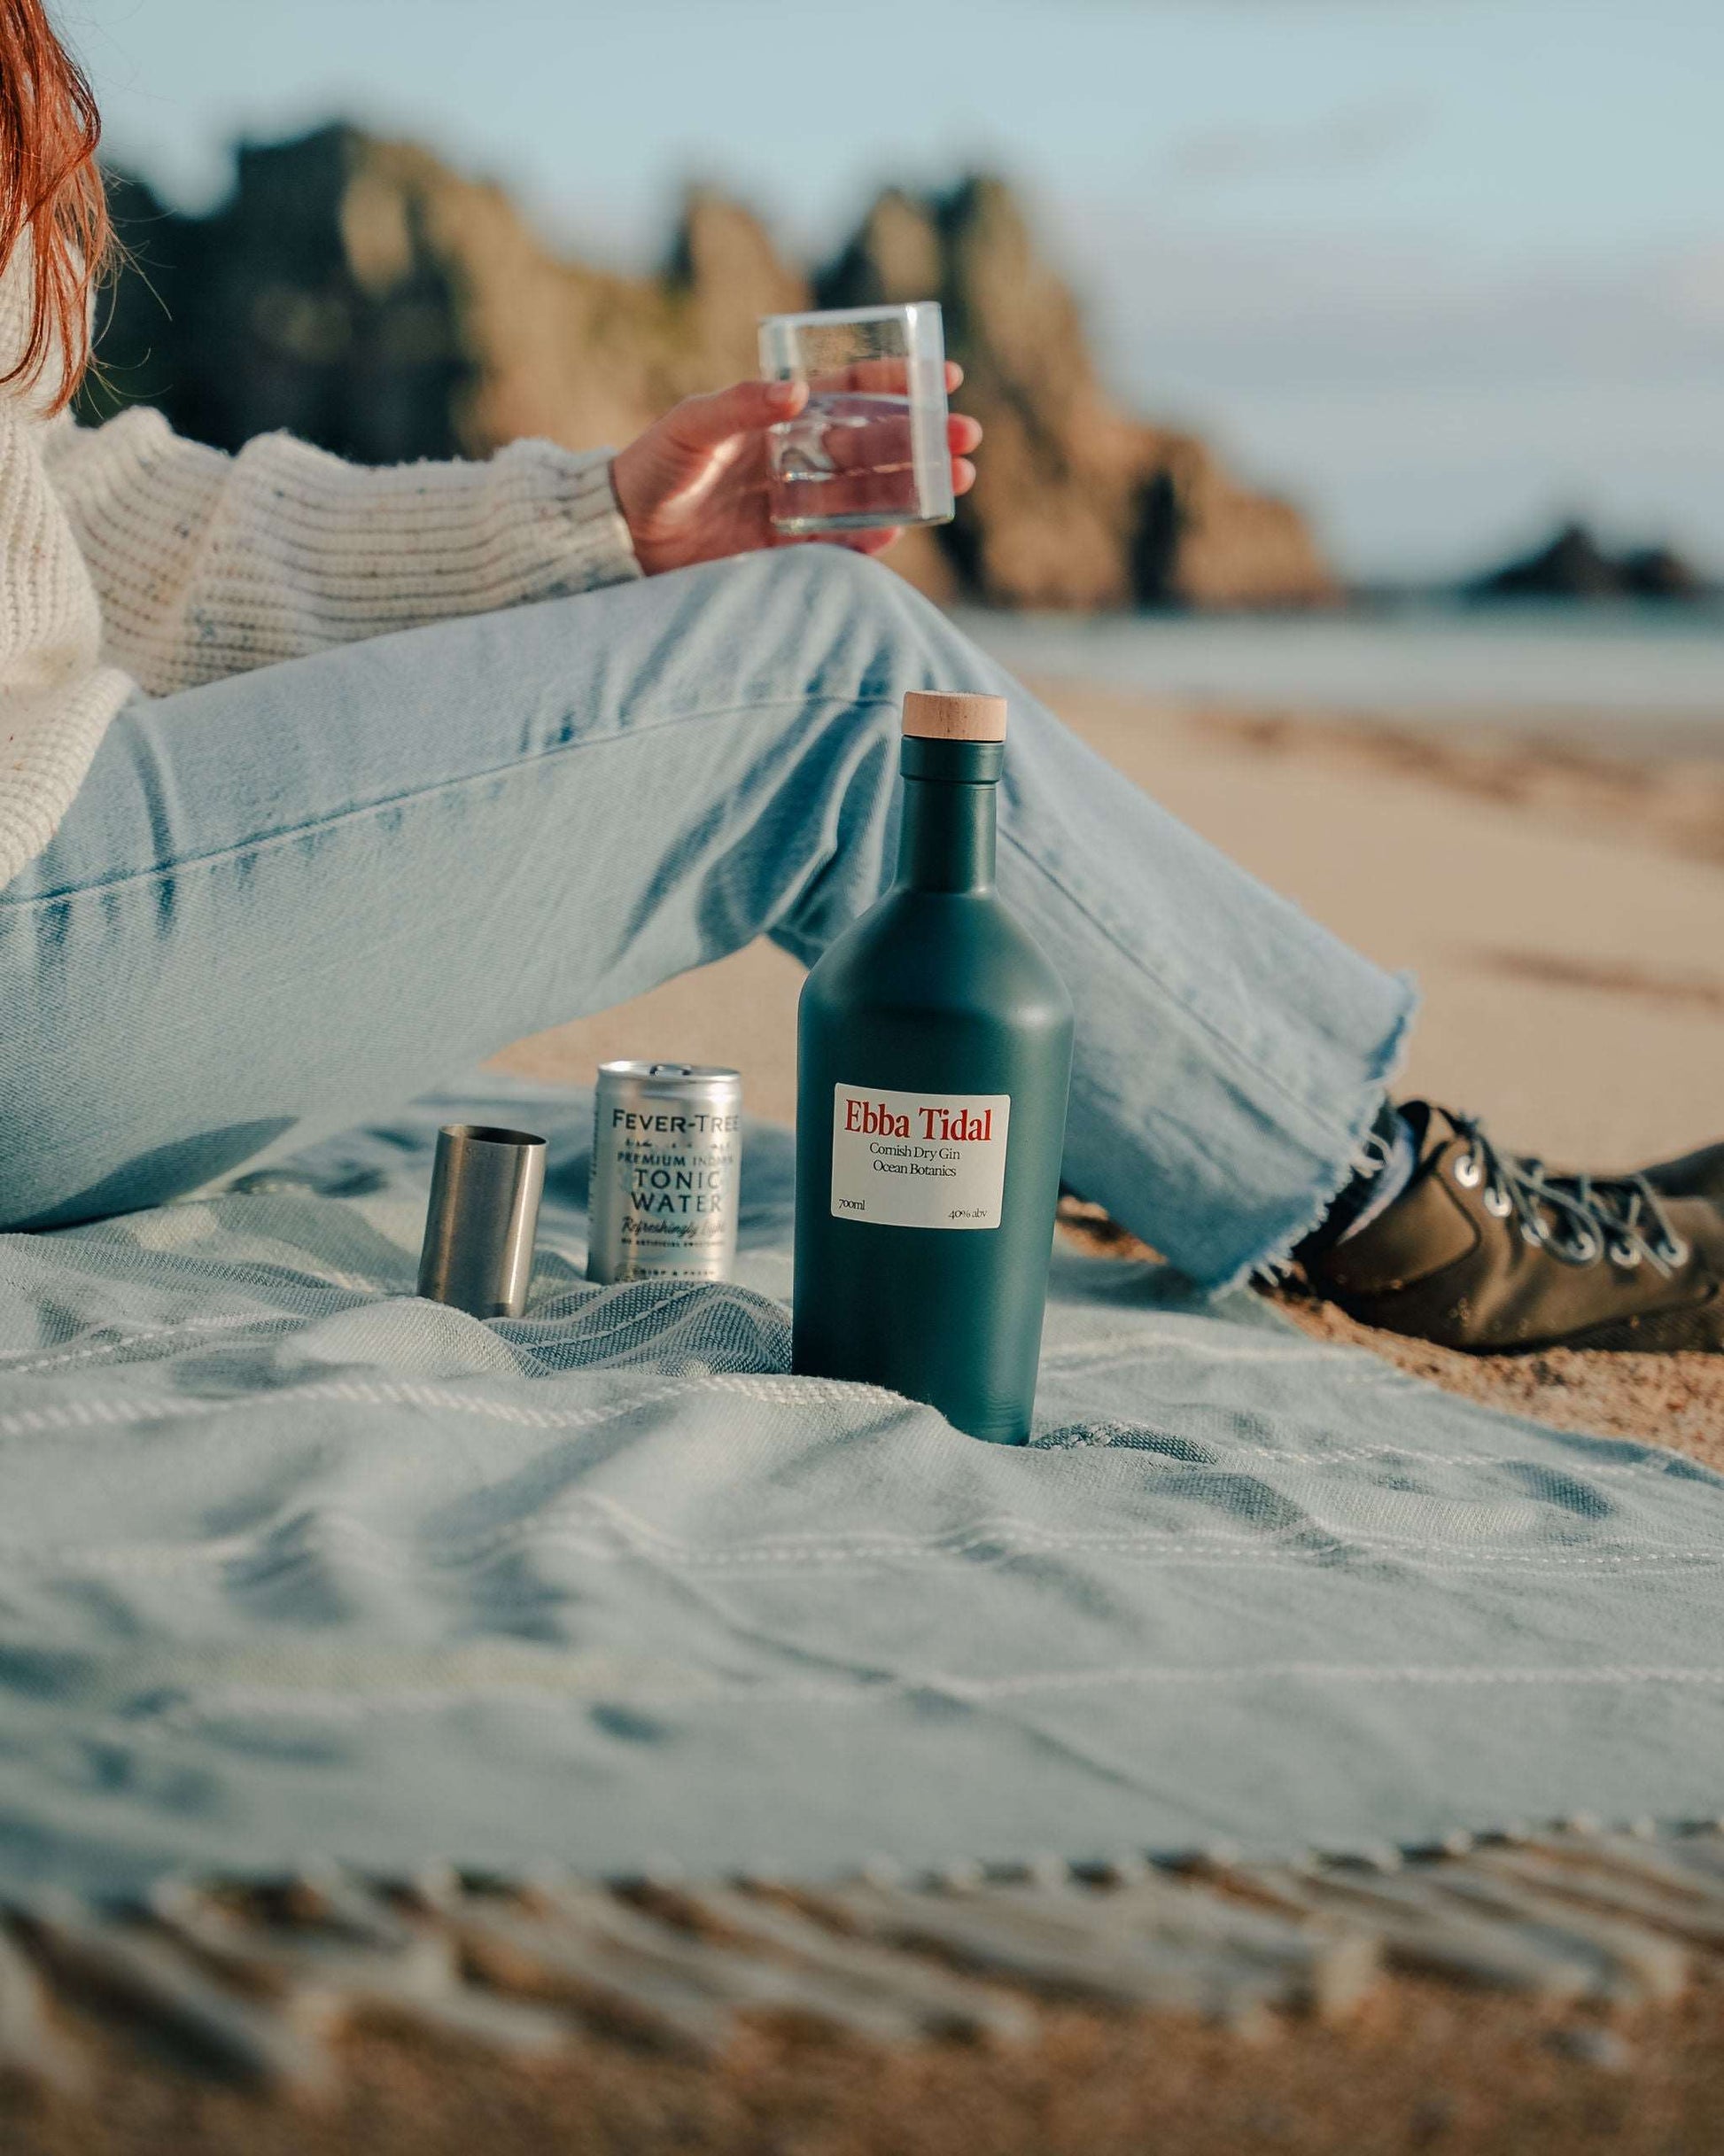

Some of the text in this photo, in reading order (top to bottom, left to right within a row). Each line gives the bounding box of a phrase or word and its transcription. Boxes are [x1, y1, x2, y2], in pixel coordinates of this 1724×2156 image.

[844, 1099, 991, 1140] Ebba Tidal
[617, 1152, 686, 1166] PREMIUM
[869, 1141, 960, 1161] Cornish Dry Gin
[873, 1159, 957, 1177] Ocean Botanics
[634, 1168, 721, 1189] TONIC
[631, 1191, 721, 1212] WATER
[838, 1198, 866, 1210] 700ml
[949, 1207, 988, 1219] 40% abv
